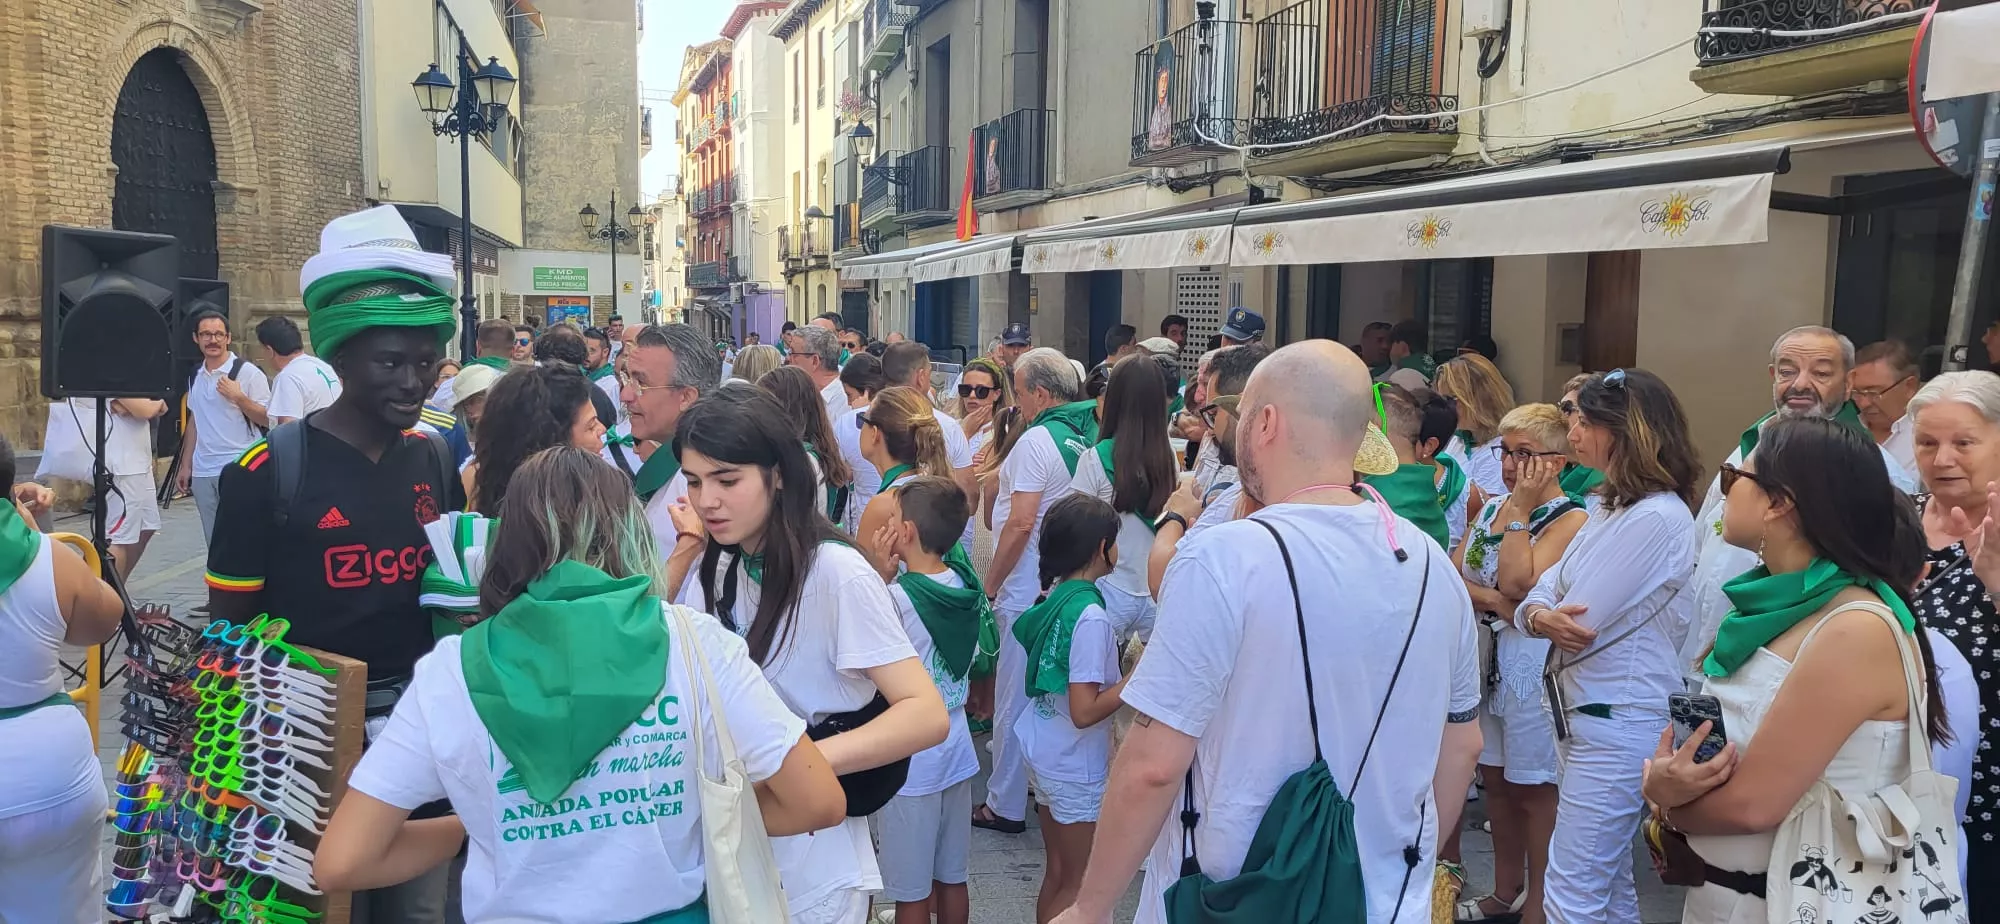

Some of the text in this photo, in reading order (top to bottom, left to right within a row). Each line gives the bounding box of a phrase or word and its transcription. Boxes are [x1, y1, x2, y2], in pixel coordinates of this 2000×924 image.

[633, 731, 687, 744] COMARCA
[608, 744, 685, 774] marcha
[589, 810, 617, 830] EL
[621, 800, 683, 825] CÁNER
